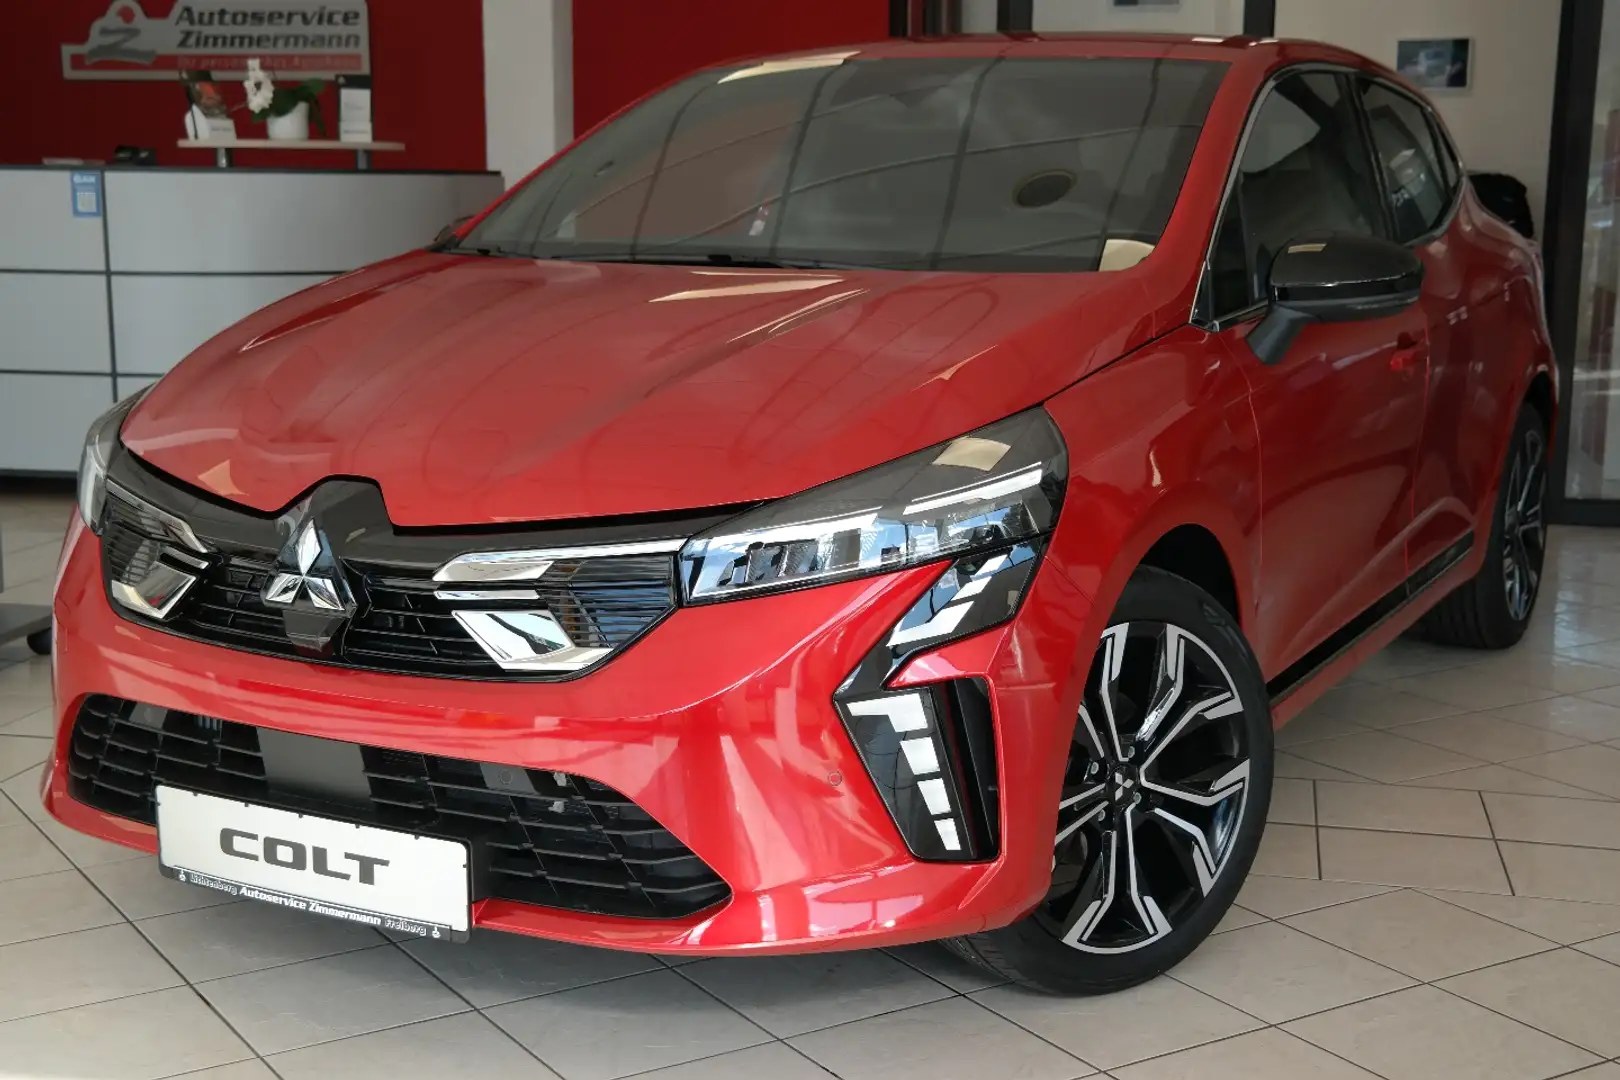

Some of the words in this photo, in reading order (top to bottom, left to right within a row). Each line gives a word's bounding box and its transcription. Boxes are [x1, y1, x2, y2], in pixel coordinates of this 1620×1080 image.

[175, 5, 361, 27] Autoservice
[177, 30, 361, 49] Zimmermann
[219, 827, 390, 886] COLT
[239, 886, 307, 910] Autoservice
[308, 901, 382, 925] Zimmermann
